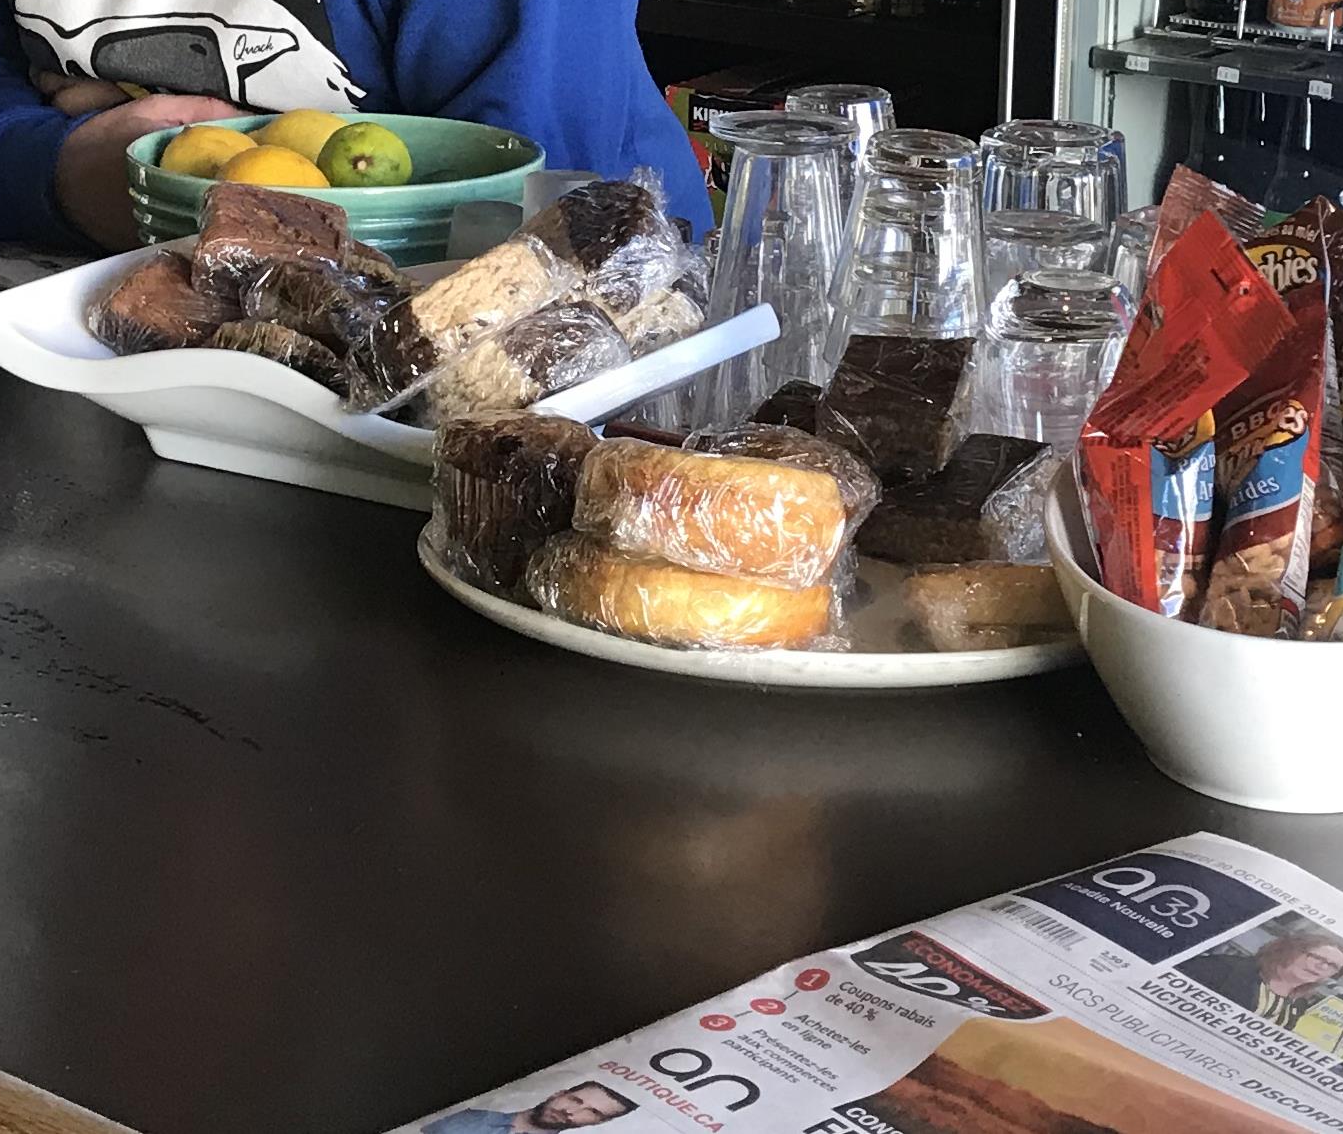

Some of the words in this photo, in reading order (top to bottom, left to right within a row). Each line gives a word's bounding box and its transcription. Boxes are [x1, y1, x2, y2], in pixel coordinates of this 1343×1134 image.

[1059, 881, 1108, 906] Acadie
[1111, 900, 1175, 939] Nouvelle
[1150, 896, 1199, 928] 35
[1234, 867, 1297, 906] OCTOBRE
[1299, 903, 1337, 926] 2019
[863, 961, 961, 996] 40
[1049, 973, 1106, 1009] SACS
[824, 993, 844, 1007] de
[844, 1002, 865, 1016] 40
[865, 1007, 877, 1022] %
[839, 980, 895, 1013] Coupons
[895, 1006, 937, 1029] rabais
[1138, 980, 1228, 1029] VICTOIRE
[1221, 1025, 1260, 1050] DES
[1156, 971, 1235, 1016] FOYERS:
[1236, 1012, 1336, 1068] NOUVELLE
[752, 1028, 840, 1081] Présentez-les
[780, 1020, 800, 1032] en
[798, 1028, 833, 1050] ligne
[793, 1013, 872, 1055] Achetez-les
[720, 1037, 801, 1085] participants
[737, 1034, 762, 1048] aux
[762, 1048, 839, 1093] commerces
[598, 1060, 725, 1134] BOUTIQUE.CA
